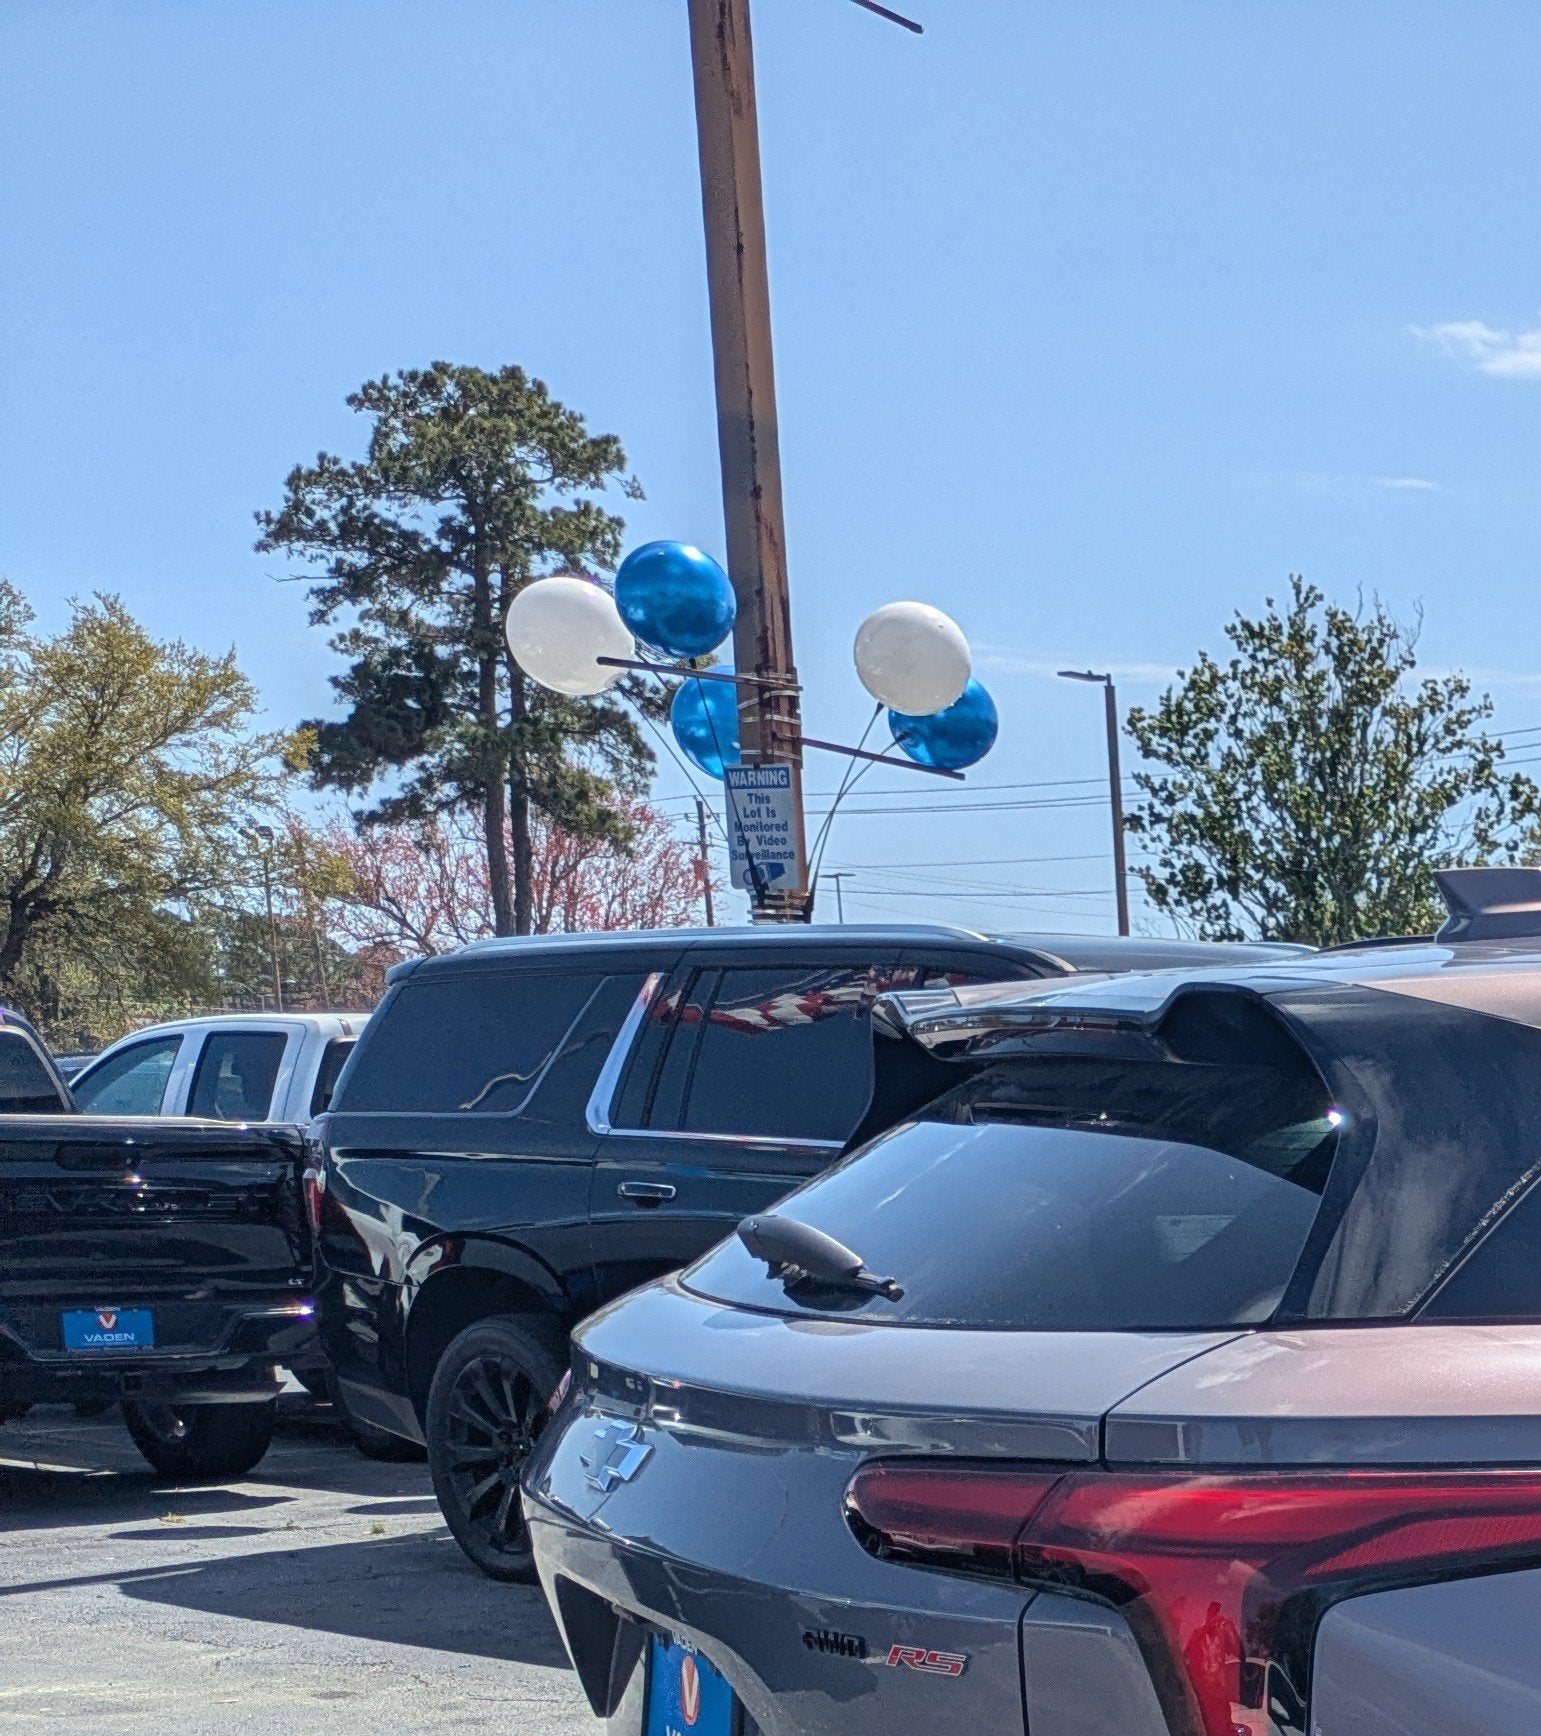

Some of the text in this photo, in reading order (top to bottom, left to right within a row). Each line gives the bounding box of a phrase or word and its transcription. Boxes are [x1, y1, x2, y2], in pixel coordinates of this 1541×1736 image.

[729, 770, 788, 787] WARNING
[746, 793, 771, 805] This
[743, 807, 776, 818] Lot Is
[734, 820, 789, 832] Monitored
[756, 835, 787, 846] Video
[83, 1332, 135, 1343] VADEN
[885, 1644, 967, 1677] RS
